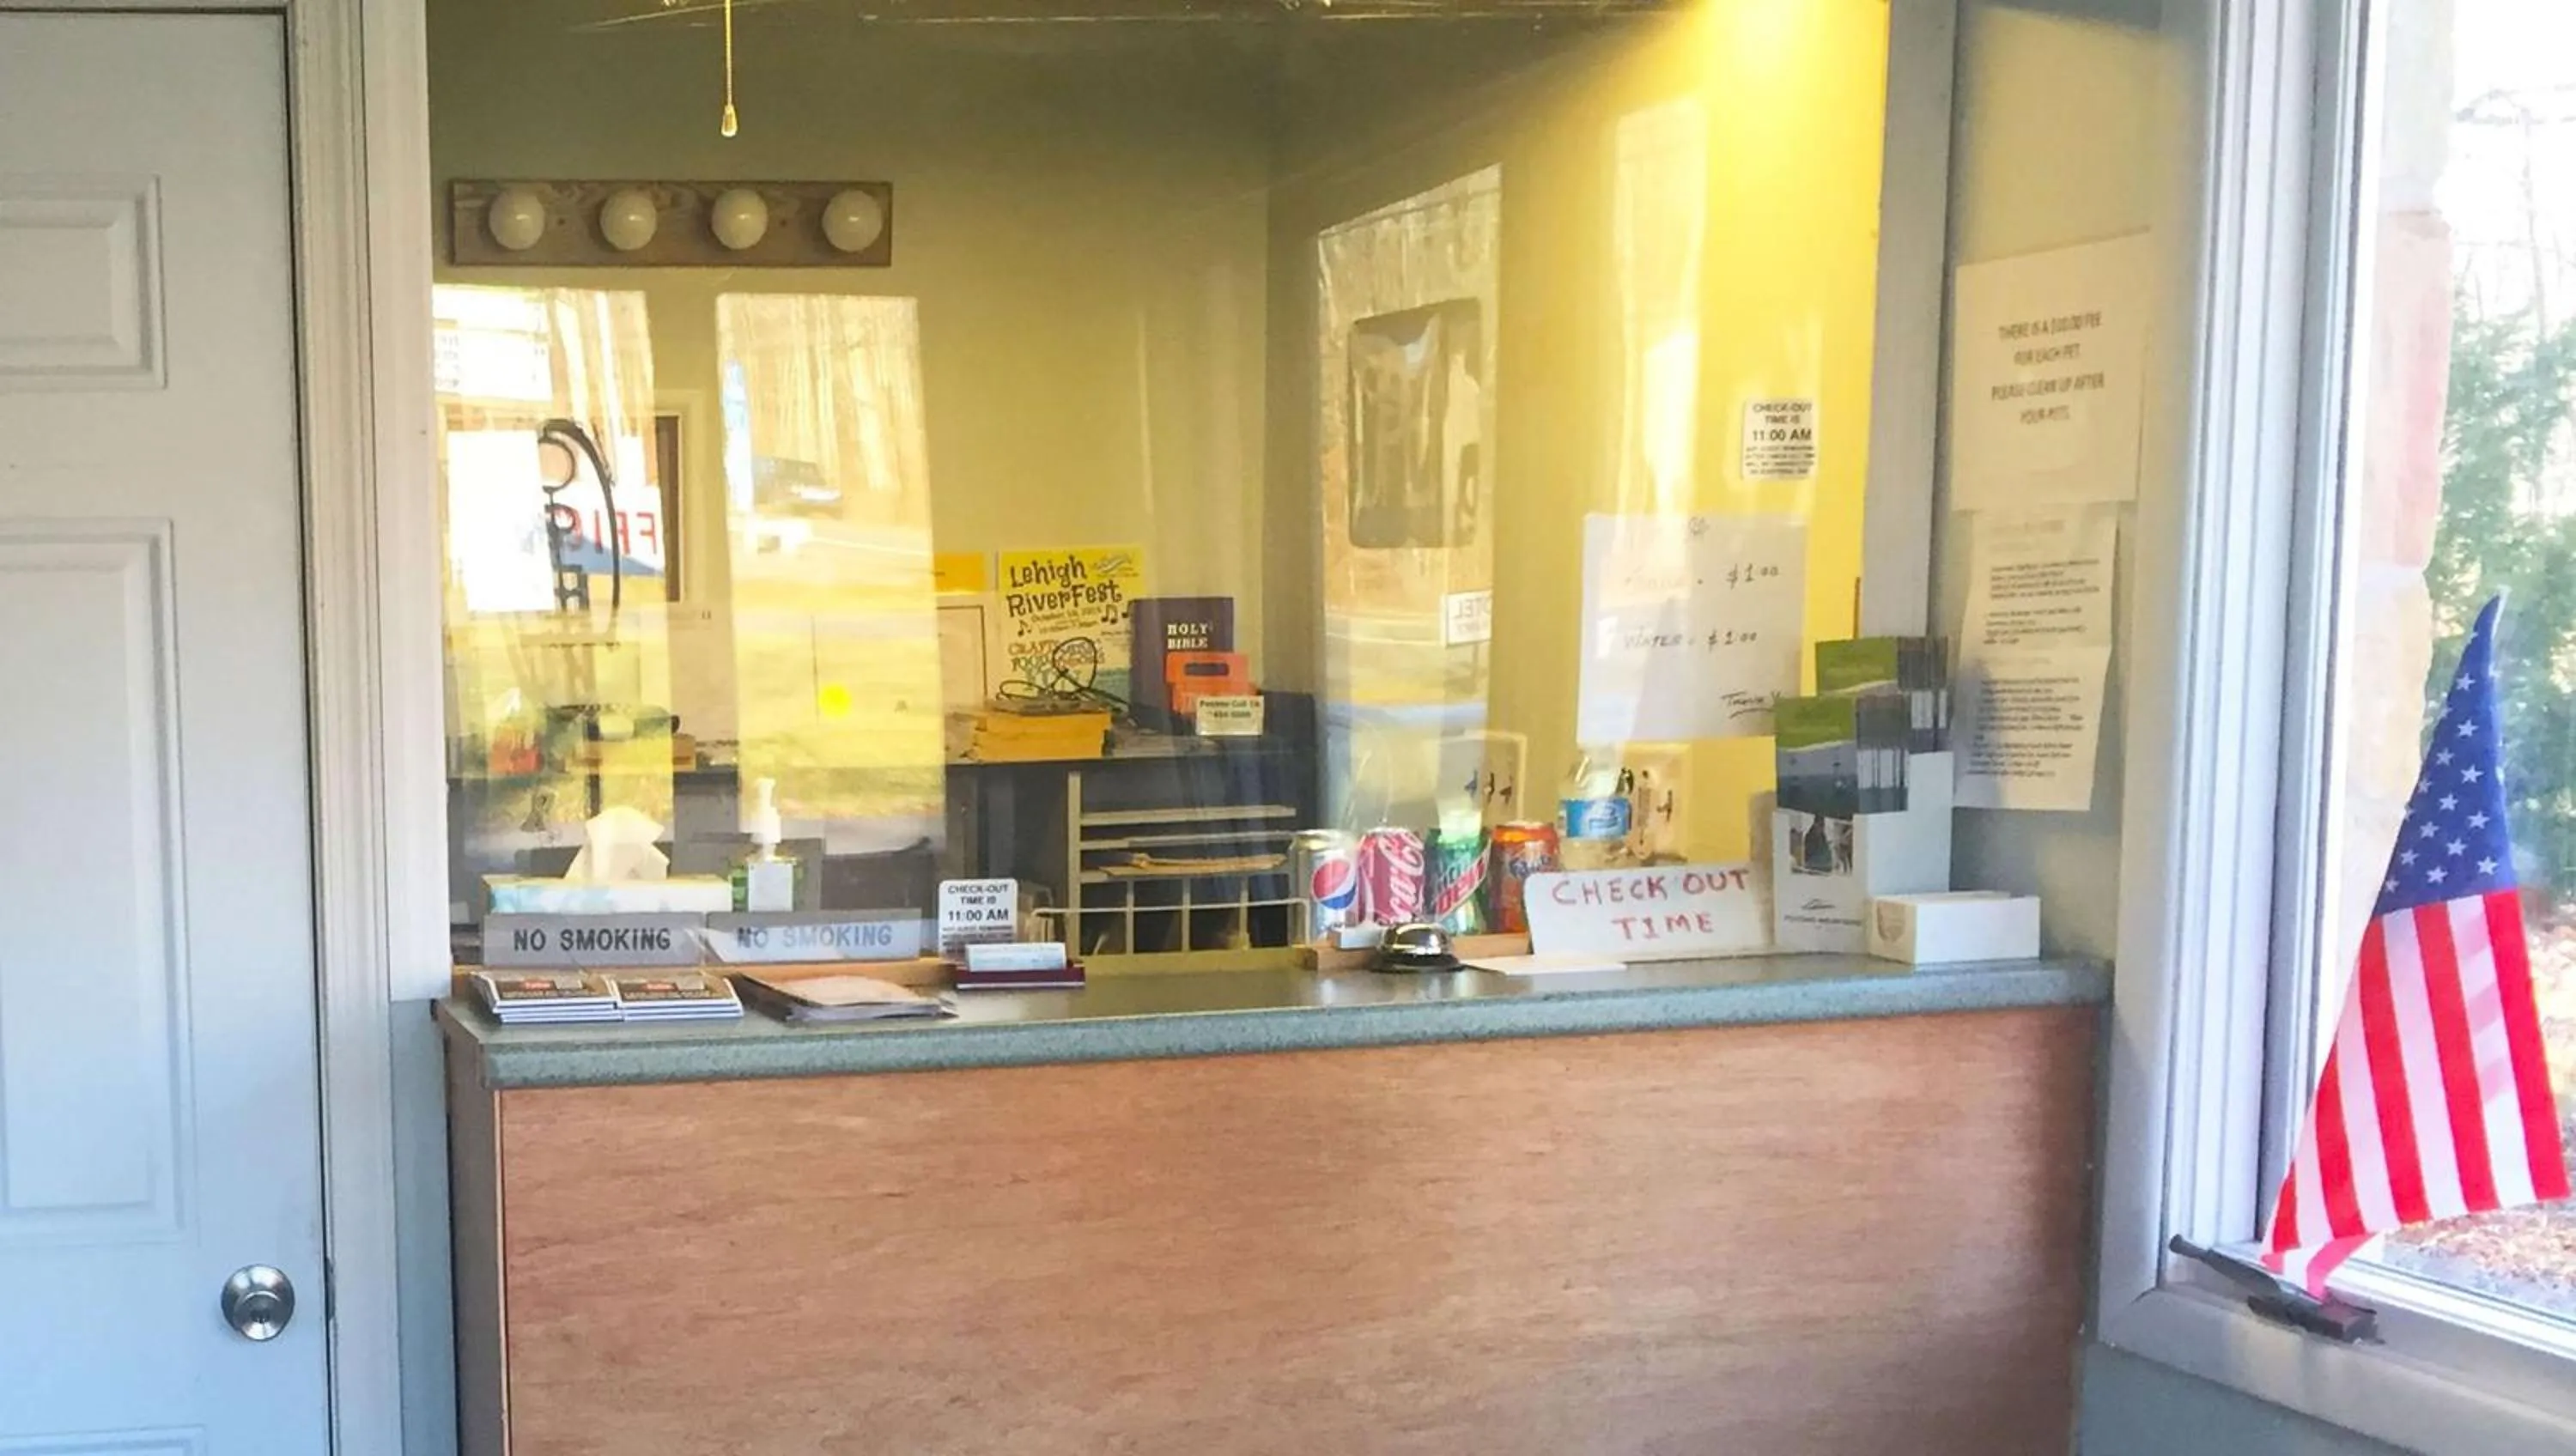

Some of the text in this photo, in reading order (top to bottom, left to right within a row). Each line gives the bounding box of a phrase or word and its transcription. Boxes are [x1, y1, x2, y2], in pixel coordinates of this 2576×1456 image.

[1789, 428, 1812, 440] AM
[1010, 555, 1087, 588] Lehigh
[1006, 579, 1122, 617] RiverFest
[1167, 623, 1208, 635] HOLY
[1167, 637, 1208, 650] BIBLE
[1552, 868, 1750, 905] CHECK OUT
[960, 895, 984, 905] TIME
[948, 908, 1009, 921] 11:00 AM
[1611, 912, 1713, 939] TIME
[513, 927, 671, 951] NO SMOKING
[737, 925, 893, 949] NO SMOKING
